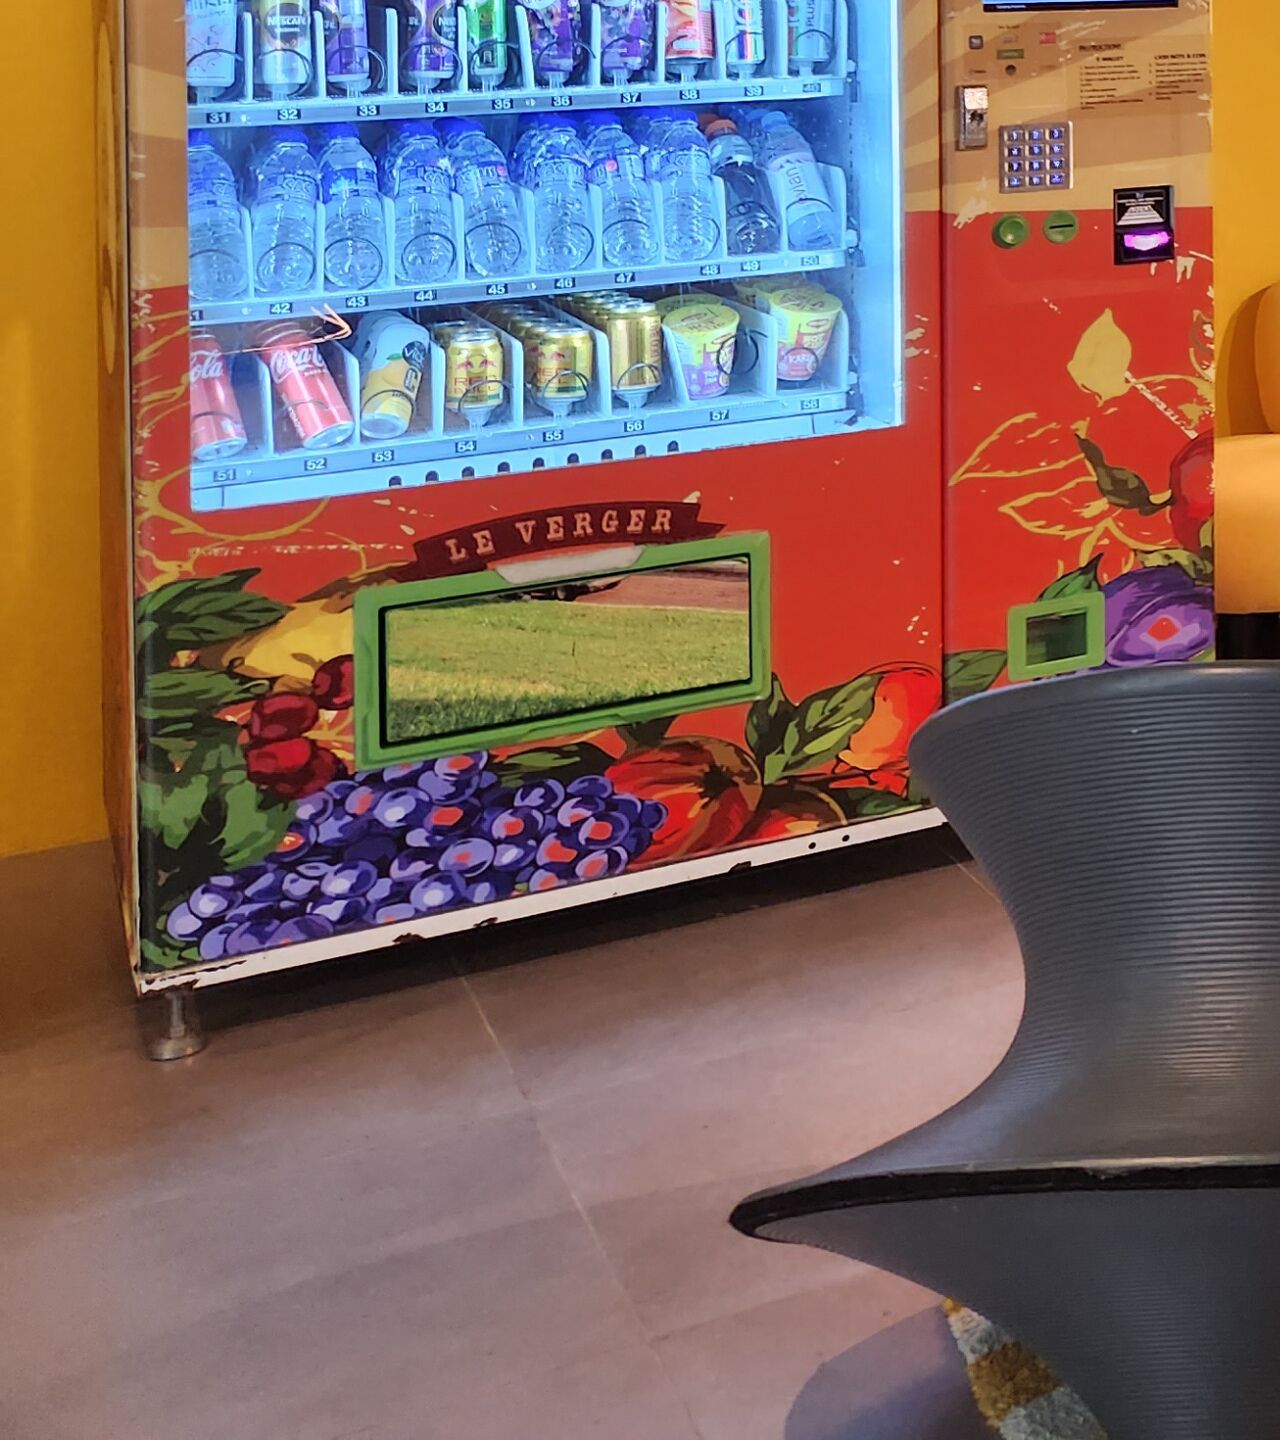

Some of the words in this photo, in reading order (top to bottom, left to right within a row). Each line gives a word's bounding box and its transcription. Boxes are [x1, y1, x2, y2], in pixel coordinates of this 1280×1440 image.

[681, 89, 698, 99] 38
[746, 86, 762, 97] 39
[553, 96, 570, 106] 36
[622, 92, 639, 103] 37
[427, 102, 445, 113] 34
[494, 98, 511, 109] 35
[279, 109, 298, 120] 32
[359, 105, 378, 116] 33
[208, 112, 227, 123] 31
[701, 264, 719, 275] 48
[742, 261, 759, 272] 49
[616, 272, 633, 283] 47
[555, 278, 573, 289] 46
[488, 284, 506, 295] 45
[415, 290, 434, 301] 44
[347, 297, 367, 308] 43
[271, 303, 291, 314] 42
[711, 410, 729, 421] 57
[626, 421, 643, 432] 56
[544, 431, 562, 441] 55
[457, 441, 475, 452] 54
[374, 450, 392, 462] 53
[306, 458, 325, 470] 52
[216, 470, 235, 481] 51
[445, 530, 495, 561] LE
[515, 509, 672, 544] VERGER
